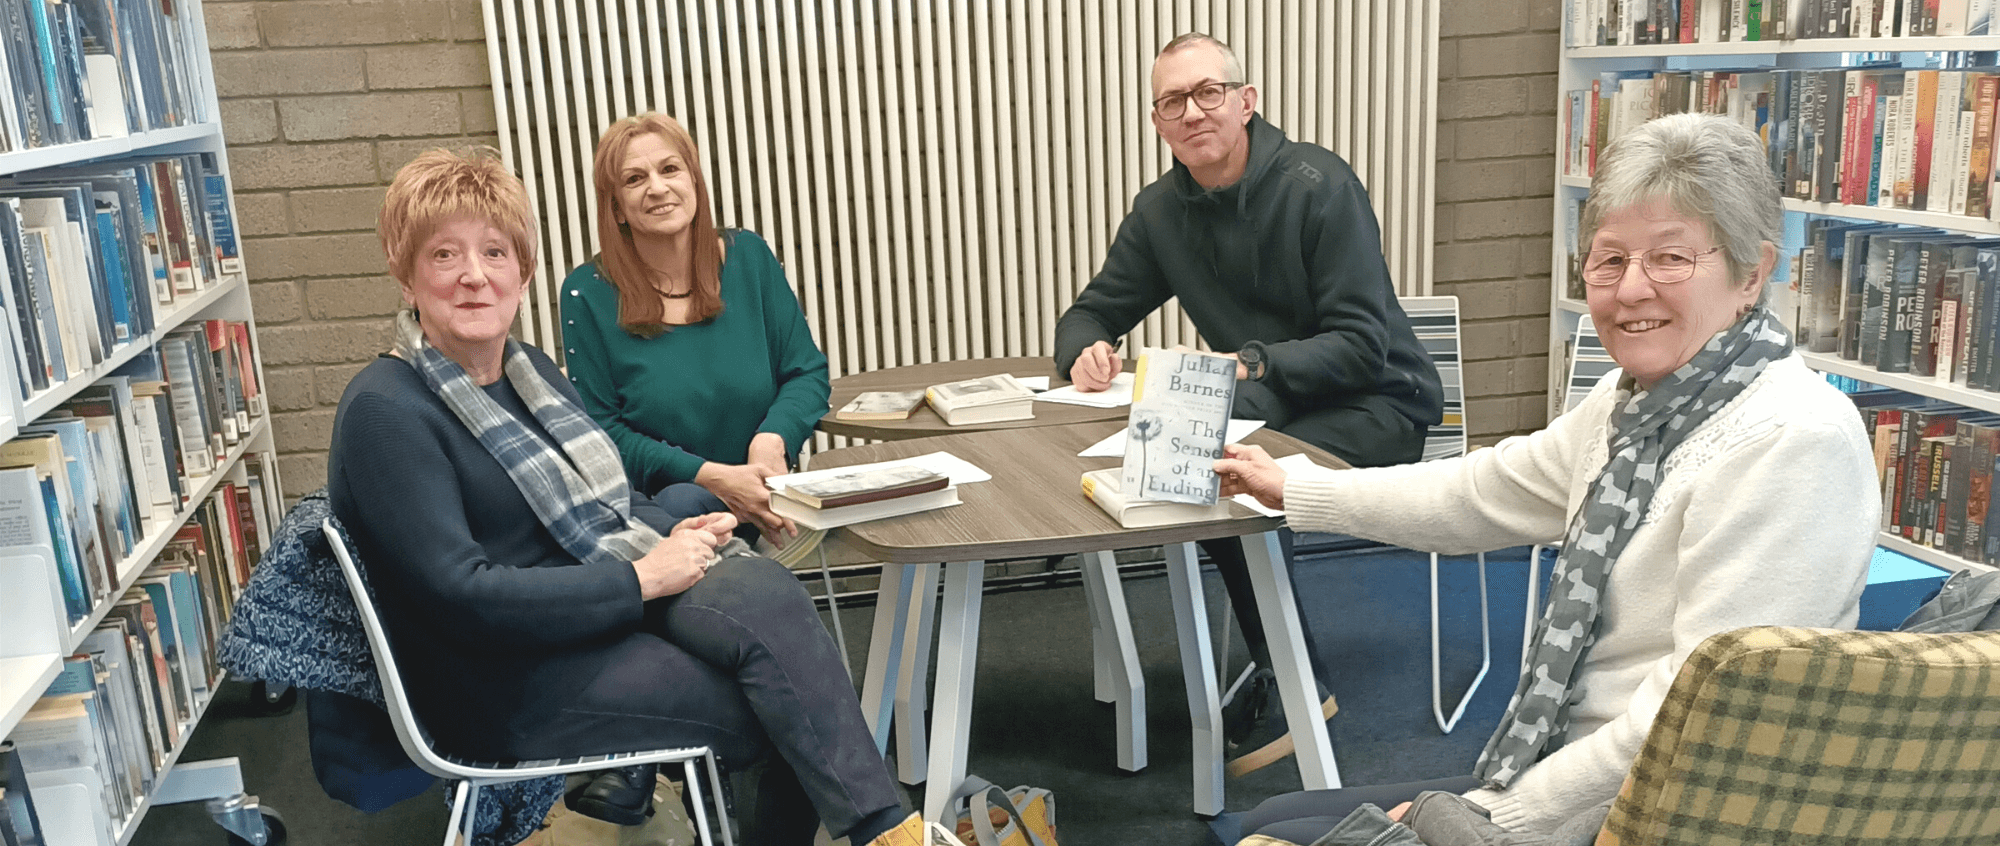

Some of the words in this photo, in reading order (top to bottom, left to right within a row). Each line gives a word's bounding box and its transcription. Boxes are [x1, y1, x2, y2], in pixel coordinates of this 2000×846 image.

[1789, 79, 1799, 109] KAREN
[1905, 78, 1915, 97] NORA
[1887, 99, 1898, 118] NORA
[1902, 99, 1914, 131] ROBERTS
[1786, 110, 1798, 151] ROBARDS
[1885, 119, 1897, 147] ROBERTS
[1964, 116, 1972, 135] nora
[1961, 137, 1971, 167] roberts
[1958, 171, 1967, 197] tribute
[178, 181, 194, 236] PATTERSON
[1885, 249, 1895, 283] PETER
[1917, 250, 1930, 284] PETER
[1878, 286, 1892, 341] ROBINSON
[1911, 288, 1926, 343] ROBINSON
[1169, 375, 1232, 399] Barnes
[1188, 419, 1224, 440] The
[1170, 437, 1222, 460] Sense
[1172, 460, 1192, 475] of
[1197, 468, 1215, 478] an
[1930, 446, 1943, 492] RUSSELL
[1147, 474, 1215, 505] Ending
